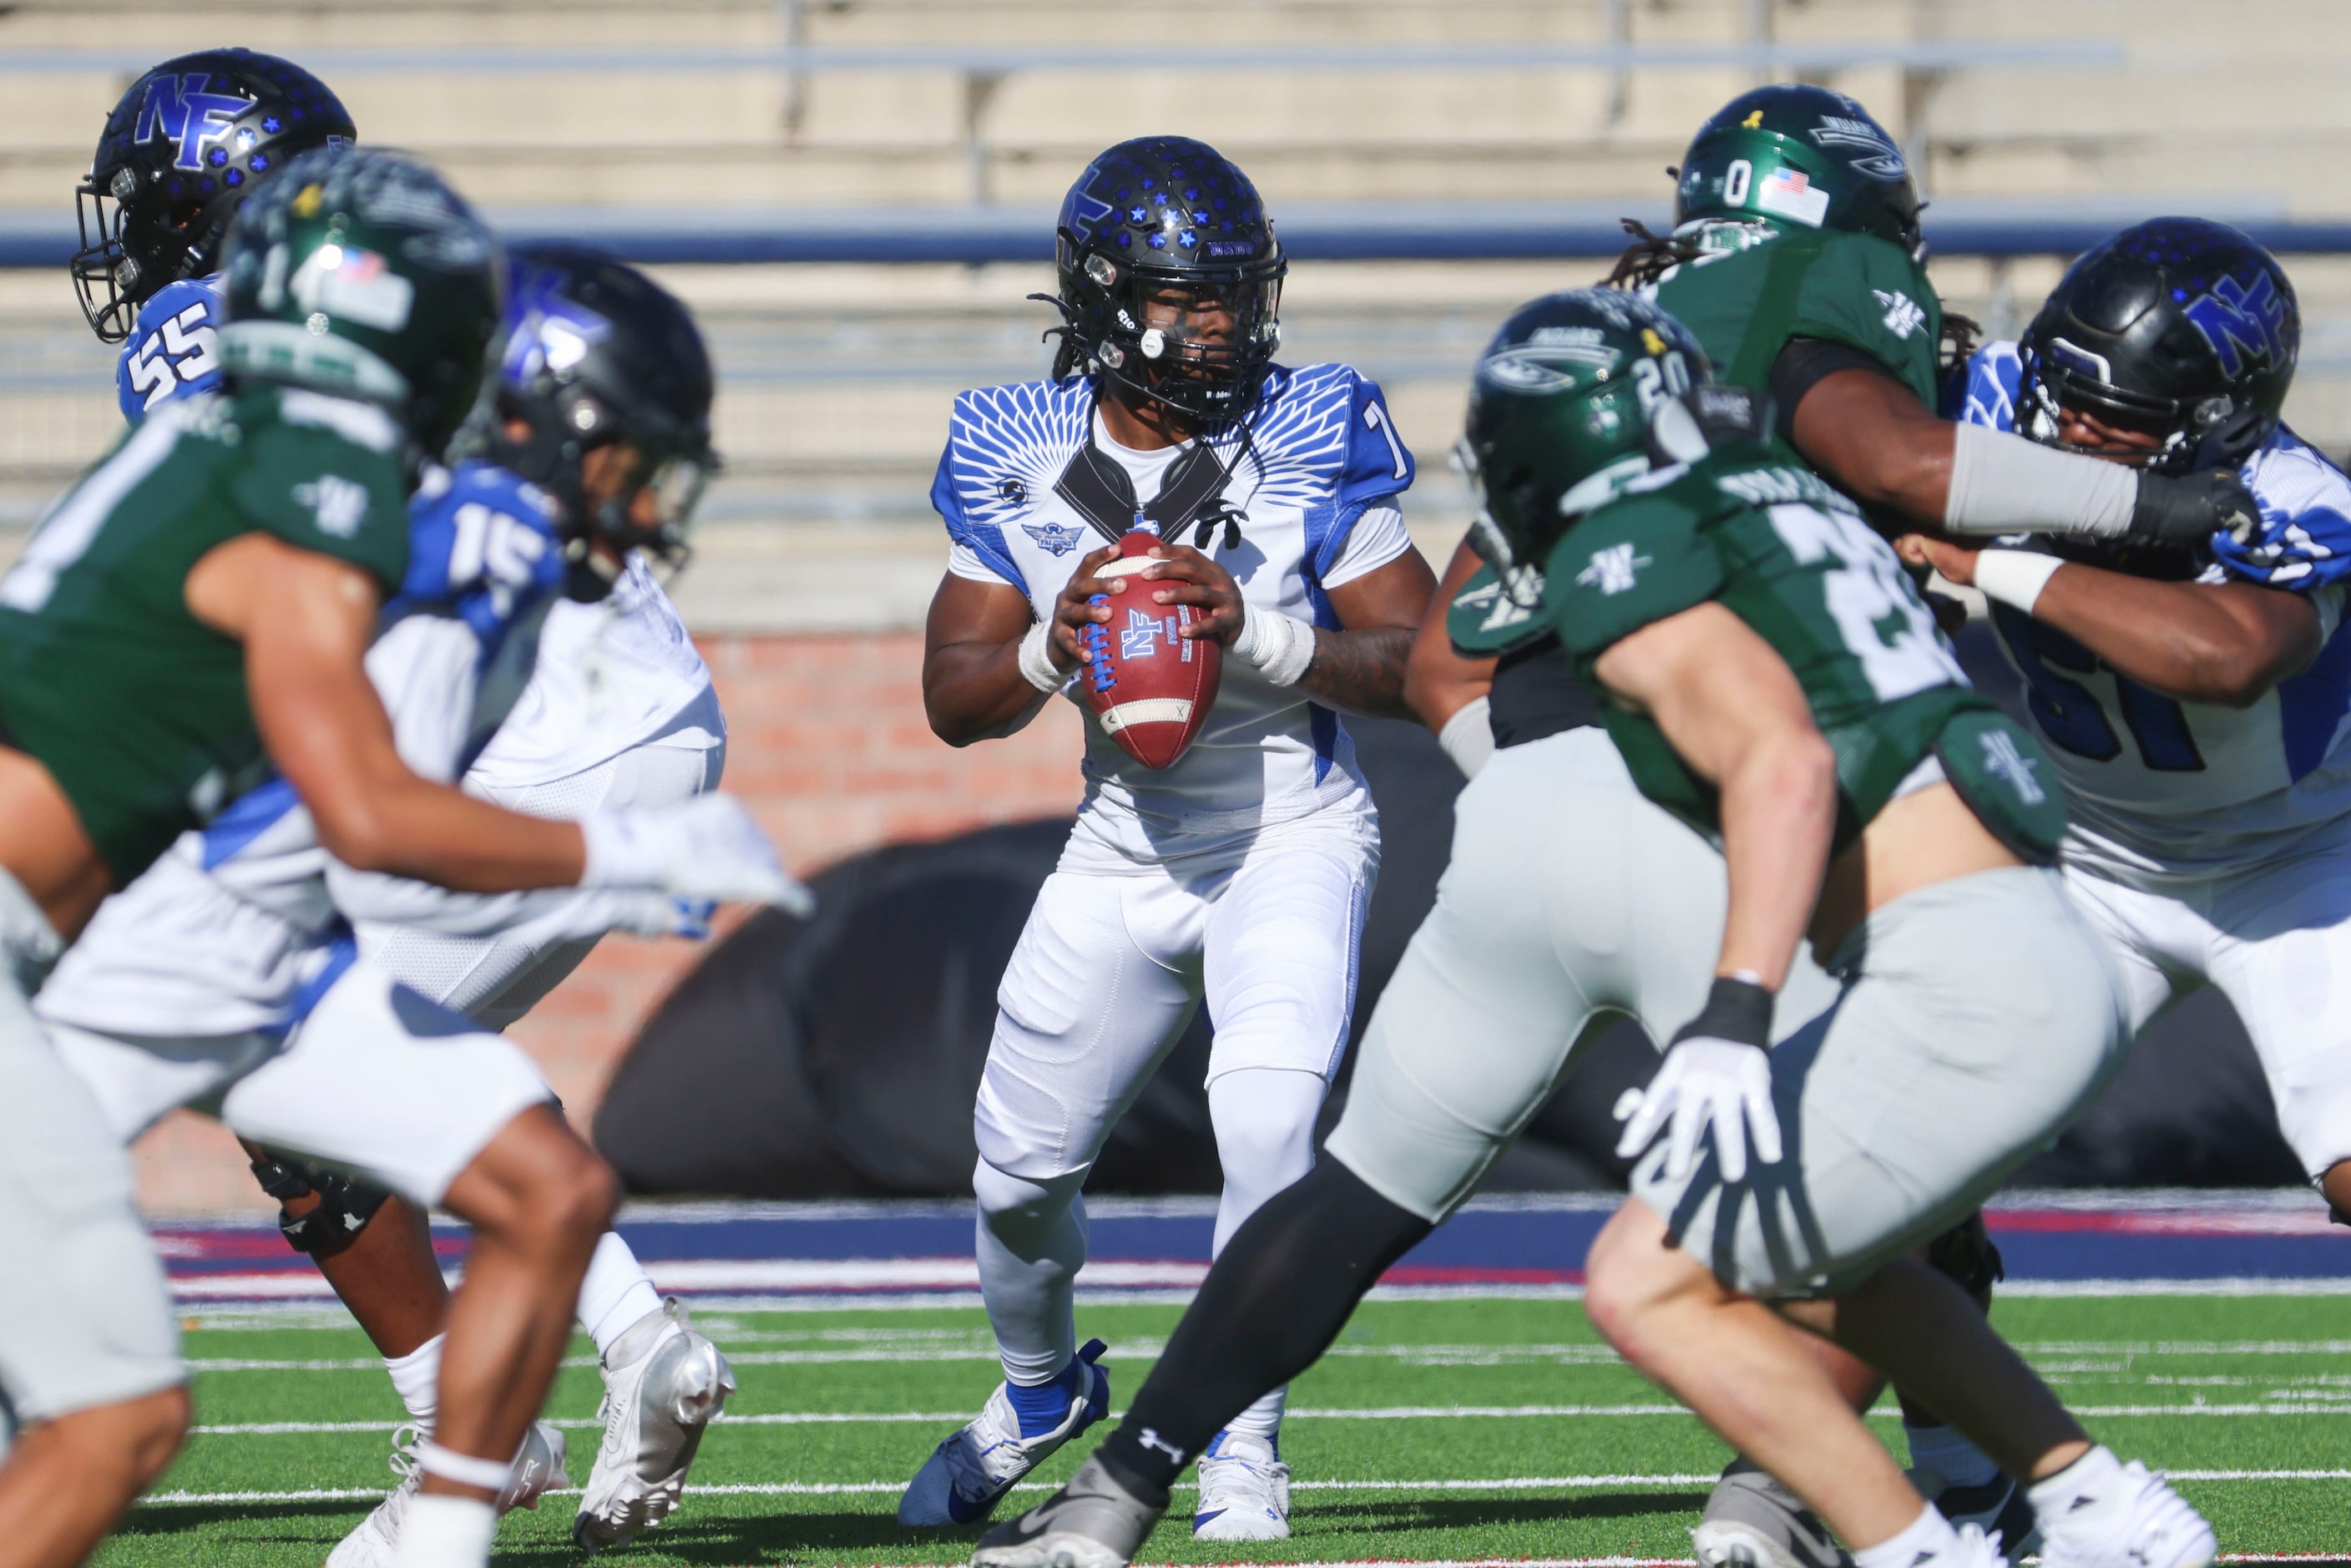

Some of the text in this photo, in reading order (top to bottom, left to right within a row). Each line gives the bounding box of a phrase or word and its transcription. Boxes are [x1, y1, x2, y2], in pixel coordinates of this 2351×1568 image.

[134, 73, 258, 172] NF
[1723, 159, 1752, 208] 0
[128, 301, 220, 413] 55
[2182, 267, 2287, 382] NF
[1121, 608, 1162, 660] NF
